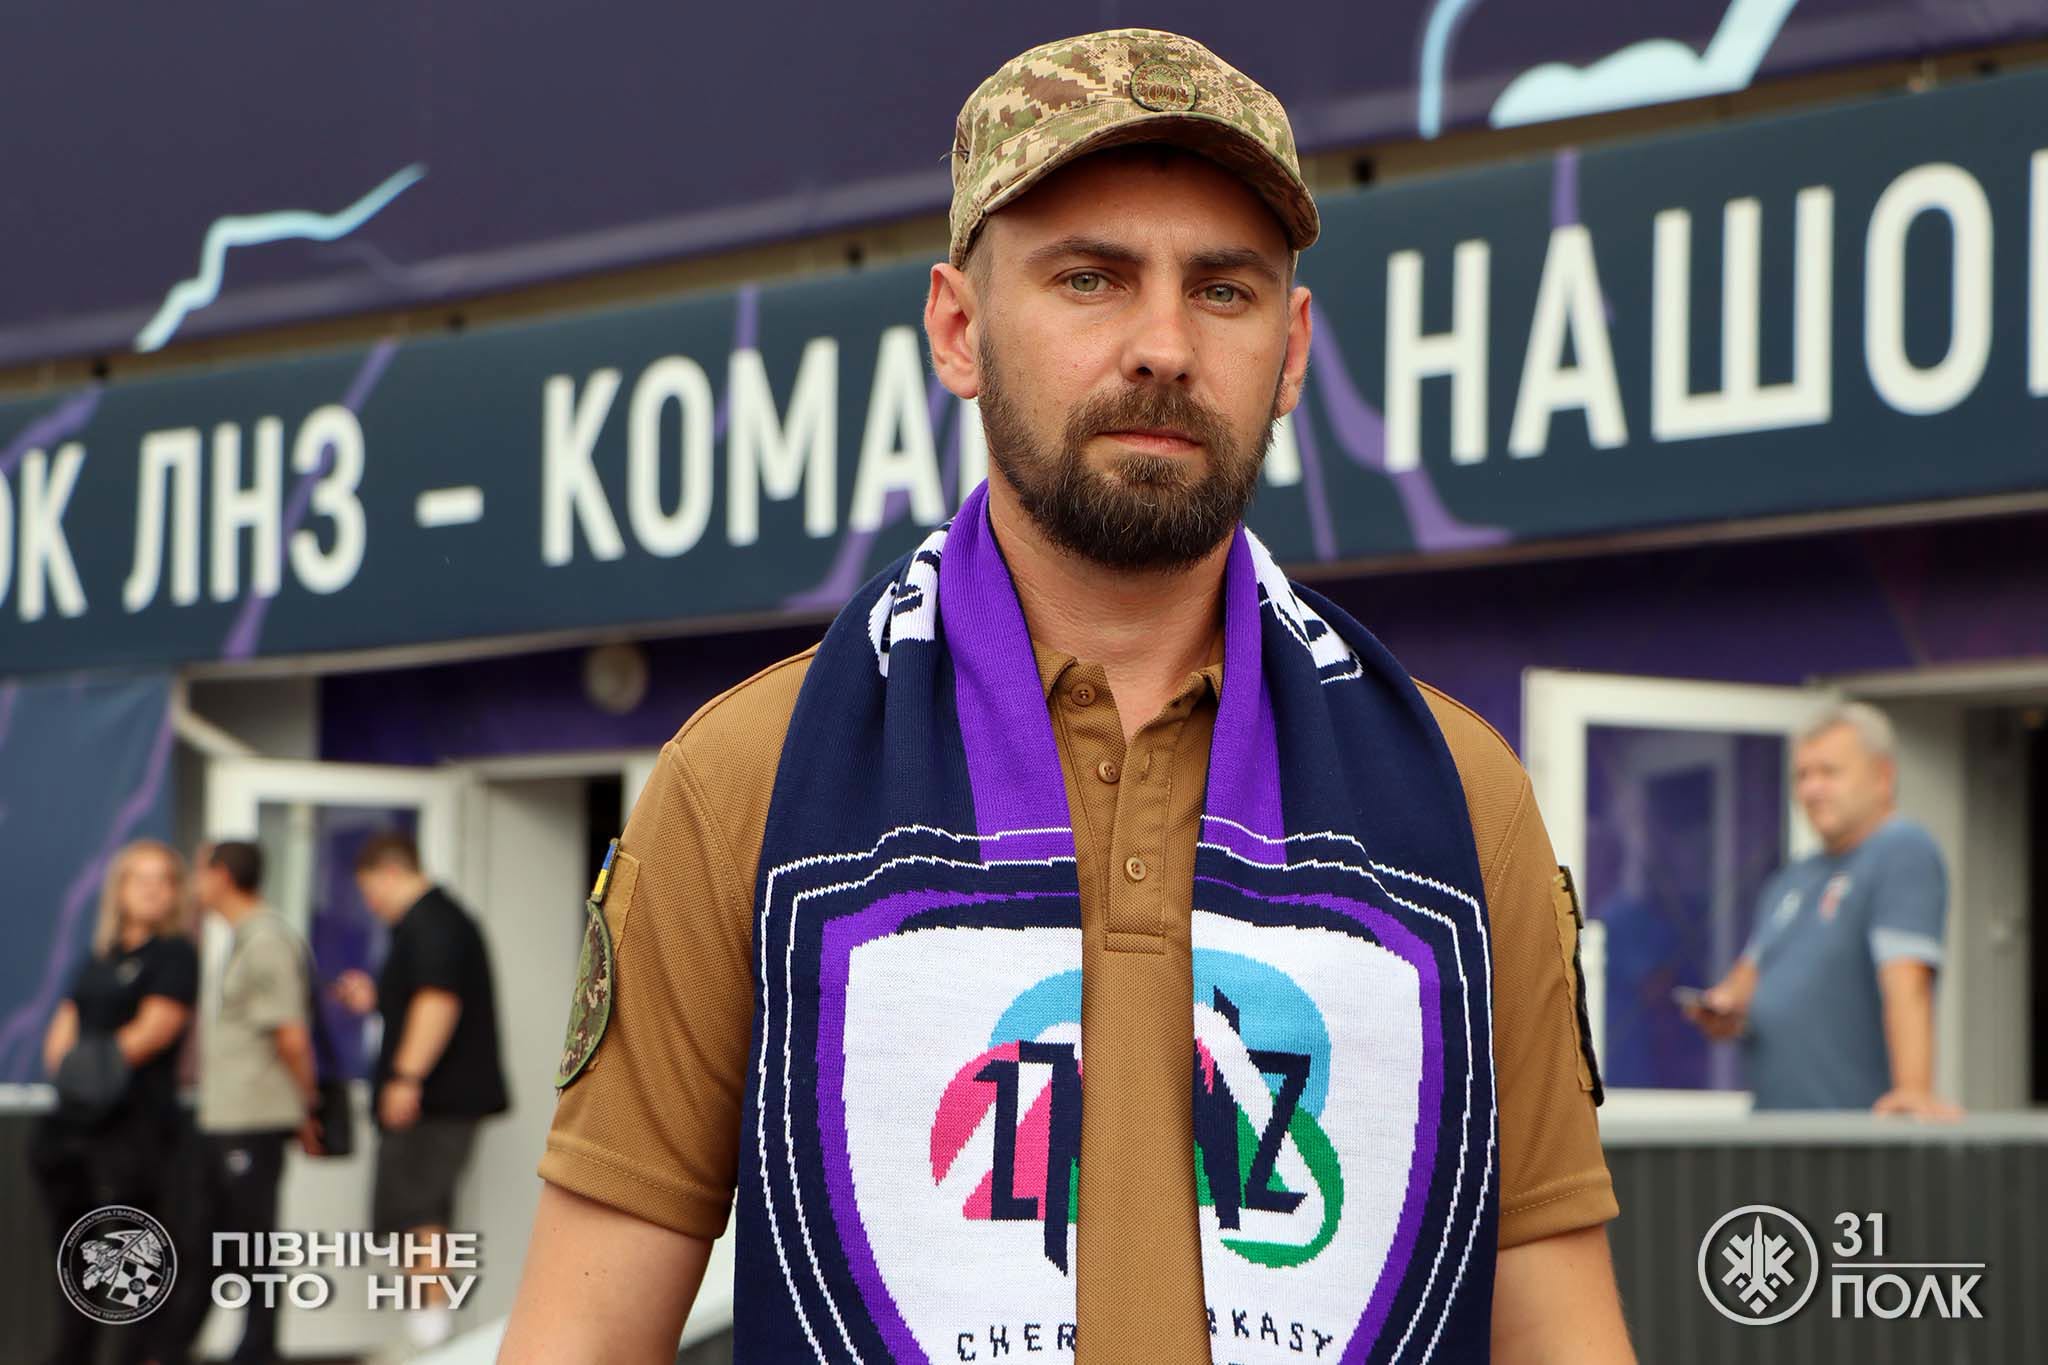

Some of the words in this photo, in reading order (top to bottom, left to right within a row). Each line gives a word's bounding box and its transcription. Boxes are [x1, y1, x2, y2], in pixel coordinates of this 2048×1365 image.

[0, 442, 88, 622] К
[123, 404, 366, 613] ЛНЗ
[1384, 147, 2048, 473] НАШО
